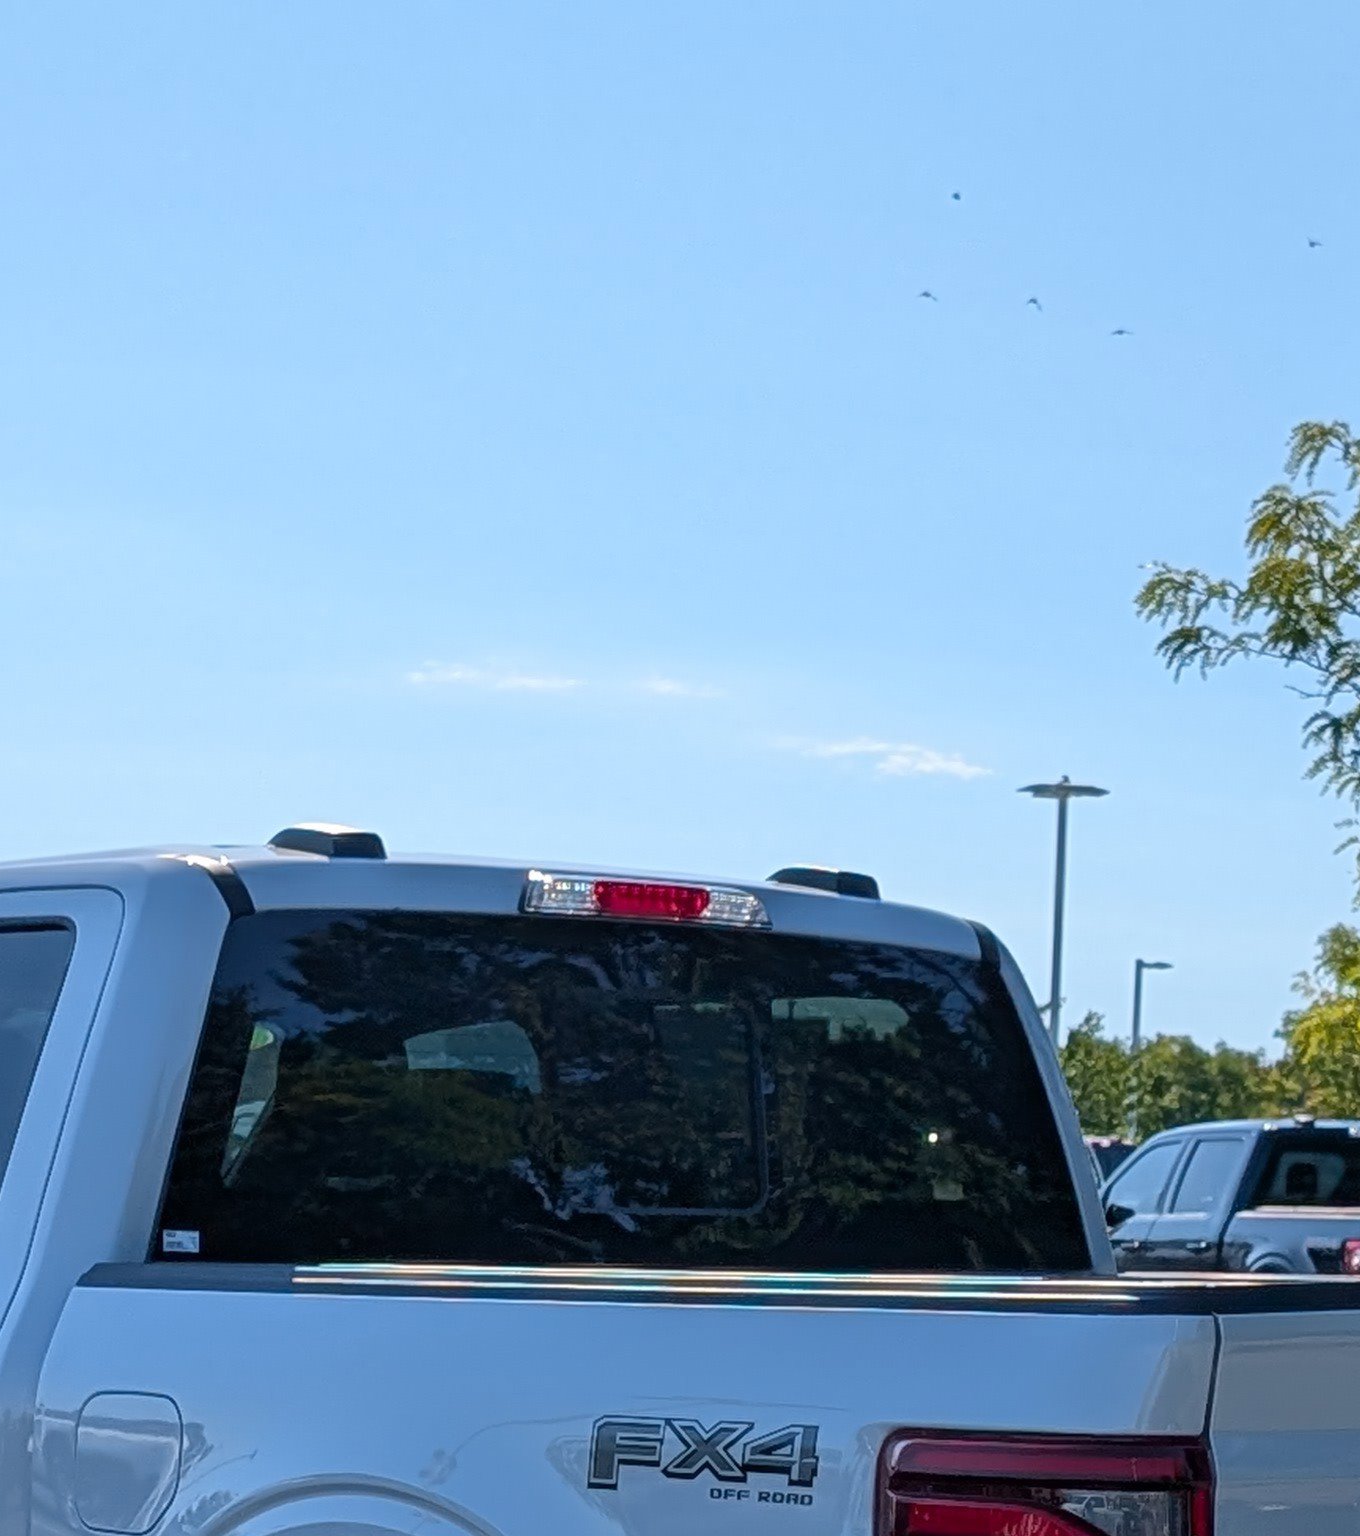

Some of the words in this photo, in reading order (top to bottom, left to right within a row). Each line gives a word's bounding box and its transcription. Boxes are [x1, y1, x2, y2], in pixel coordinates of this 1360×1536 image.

[587, 1415, 820, 1490] FX4
[709, 1487, 751, 1501] OFF
[757, 1490, 814, 1507] ROAD
